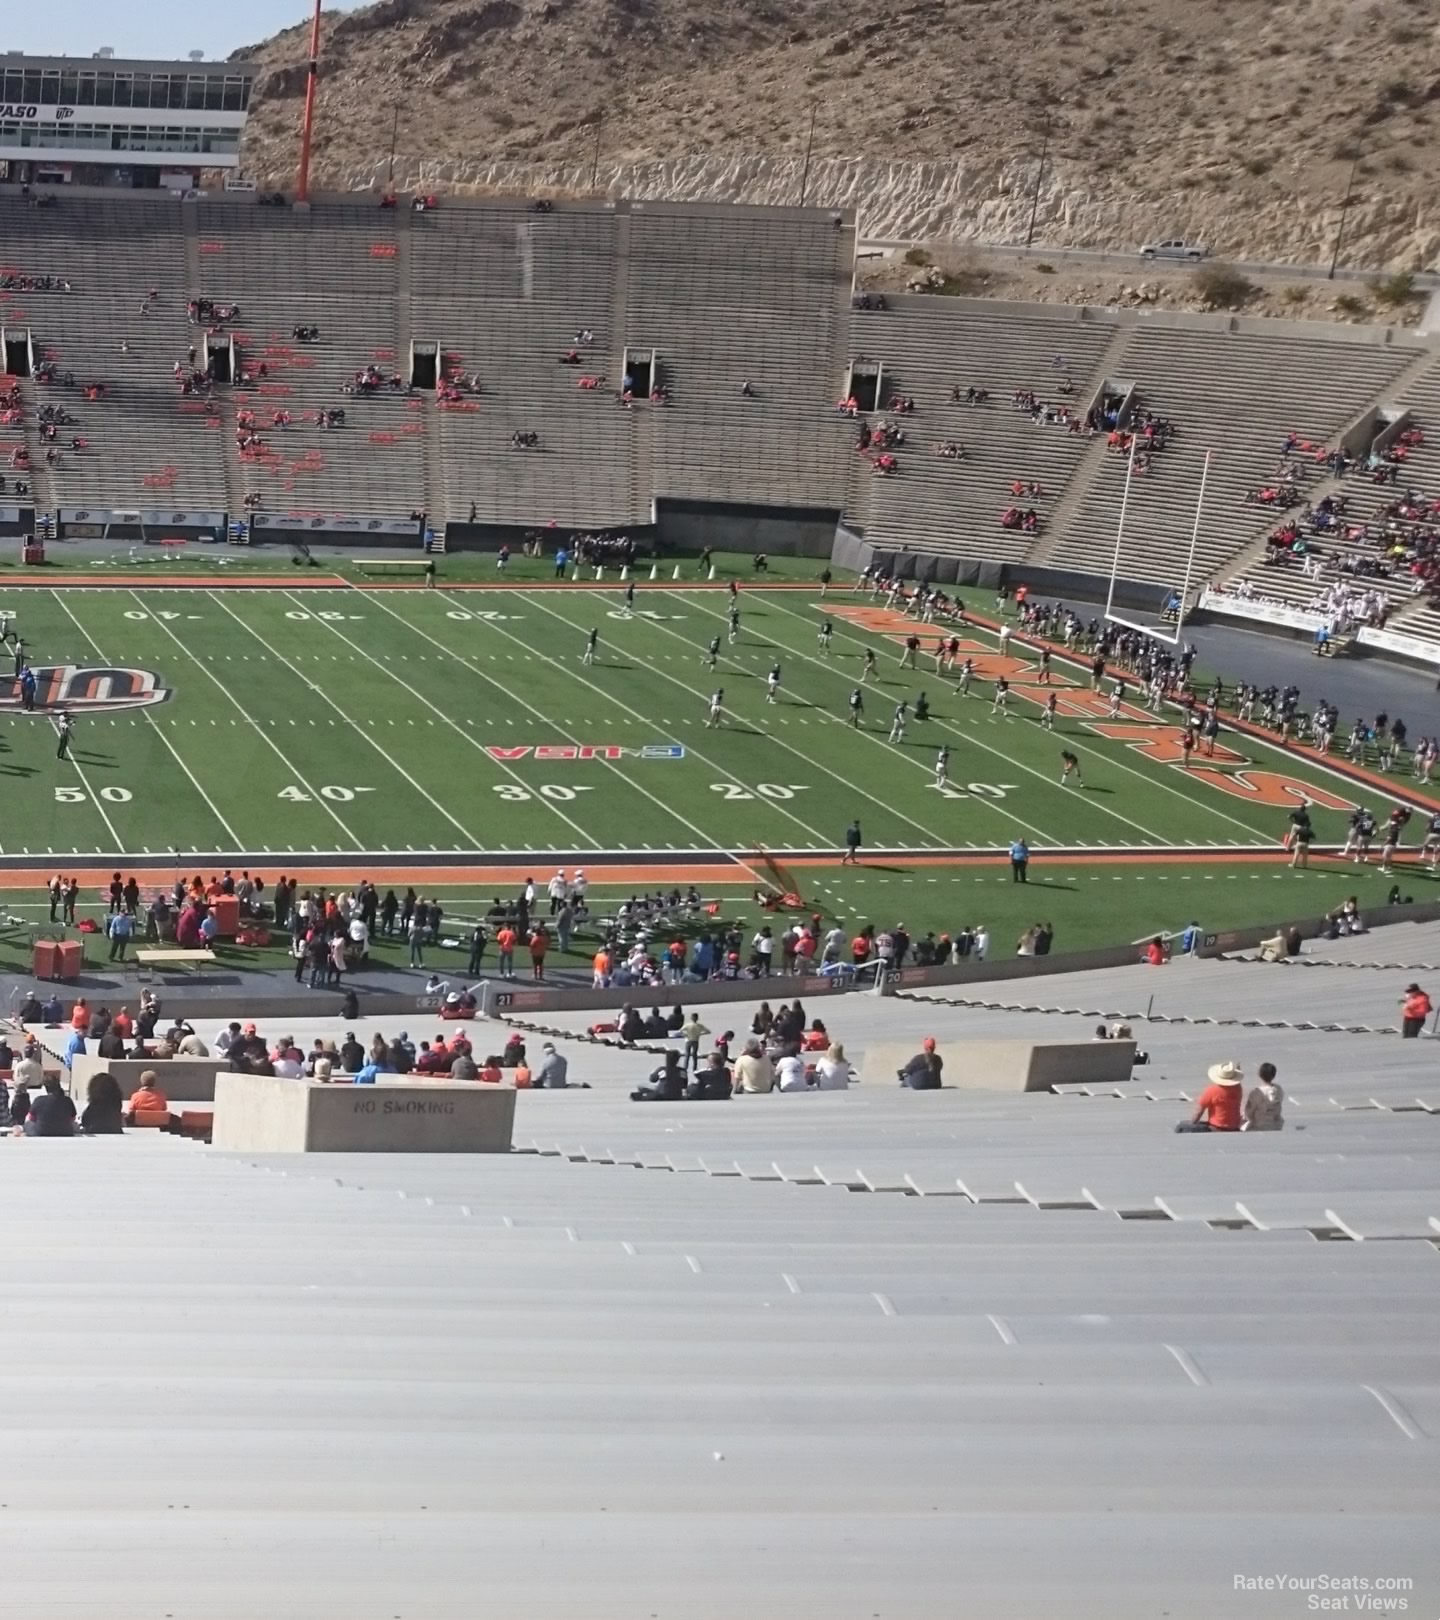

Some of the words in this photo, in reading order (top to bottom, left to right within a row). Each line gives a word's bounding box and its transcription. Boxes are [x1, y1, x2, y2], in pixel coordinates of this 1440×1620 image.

[54, 786, 133, 803] 50
[277, 784, 367, 802] 40
[492, 783, 579, 801] 30
[709, 782, 795, 800] 20
[925, 782, 1007, 799] 10
[1206, 935, 1216, 946] 19
[831, 977, 843, 988] 21
[888, 973, 901, 983] 20
[427, 997, 439, 1007] 22
[498, 994, 512, 1006] 21
[354, 1102, 376, 1114] NO
[383, 1101, 456, 1115] SMOKING
